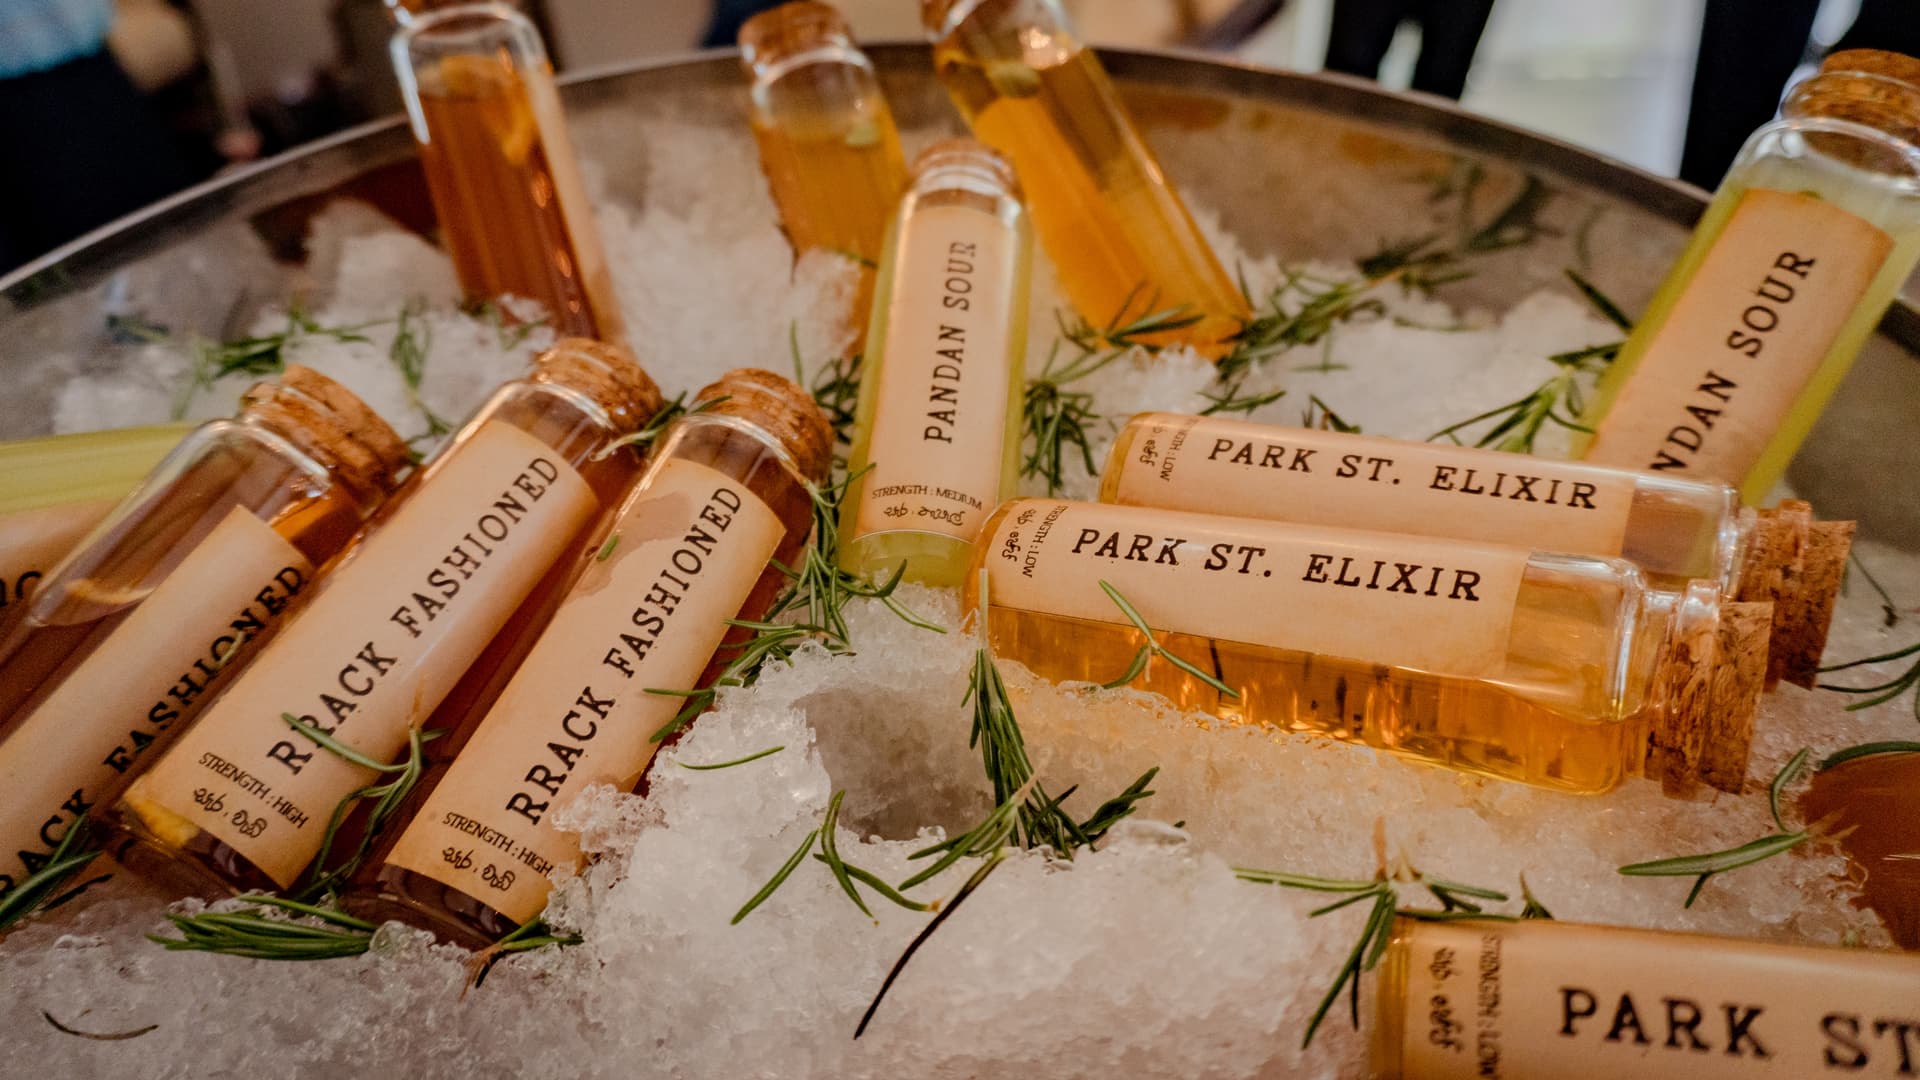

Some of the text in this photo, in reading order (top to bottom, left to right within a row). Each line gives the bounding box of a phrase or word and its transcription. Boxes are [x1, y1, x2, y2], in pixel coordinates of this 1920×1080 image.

[924, 241, 976, 444] PANDAN SOUR
[1727, 252, 1816, 358] SOUR
[872, 485, 929, 499] STRENGTH
[936, 488, 983, 511] MEDIUM
[1160, 456, 1176, 482] LOW
[1207, 437, 1598, 510] PARK ST. ELIXIR
[1032, 505, 1068, 544] STRENGTH
[1022, 549, 1039, 578] LOW
[1072, 528, 1482, 602] PARK ST. ELIXIR
[267, 457, 559, 775] RRACK FASHIONED
[103, 566, 305, 774] FASHIONED
[505, 487, 741, 826] RRACK FASHIONED
[199, 752, 271, 799] STRENGTH
[273, 796, 309, 829] HIGH
[443, 812, 515, 853] STRENGTH
[518, 847, 555, 878] HIGH
[1559, 986, 1920, 1077] PARK ST
